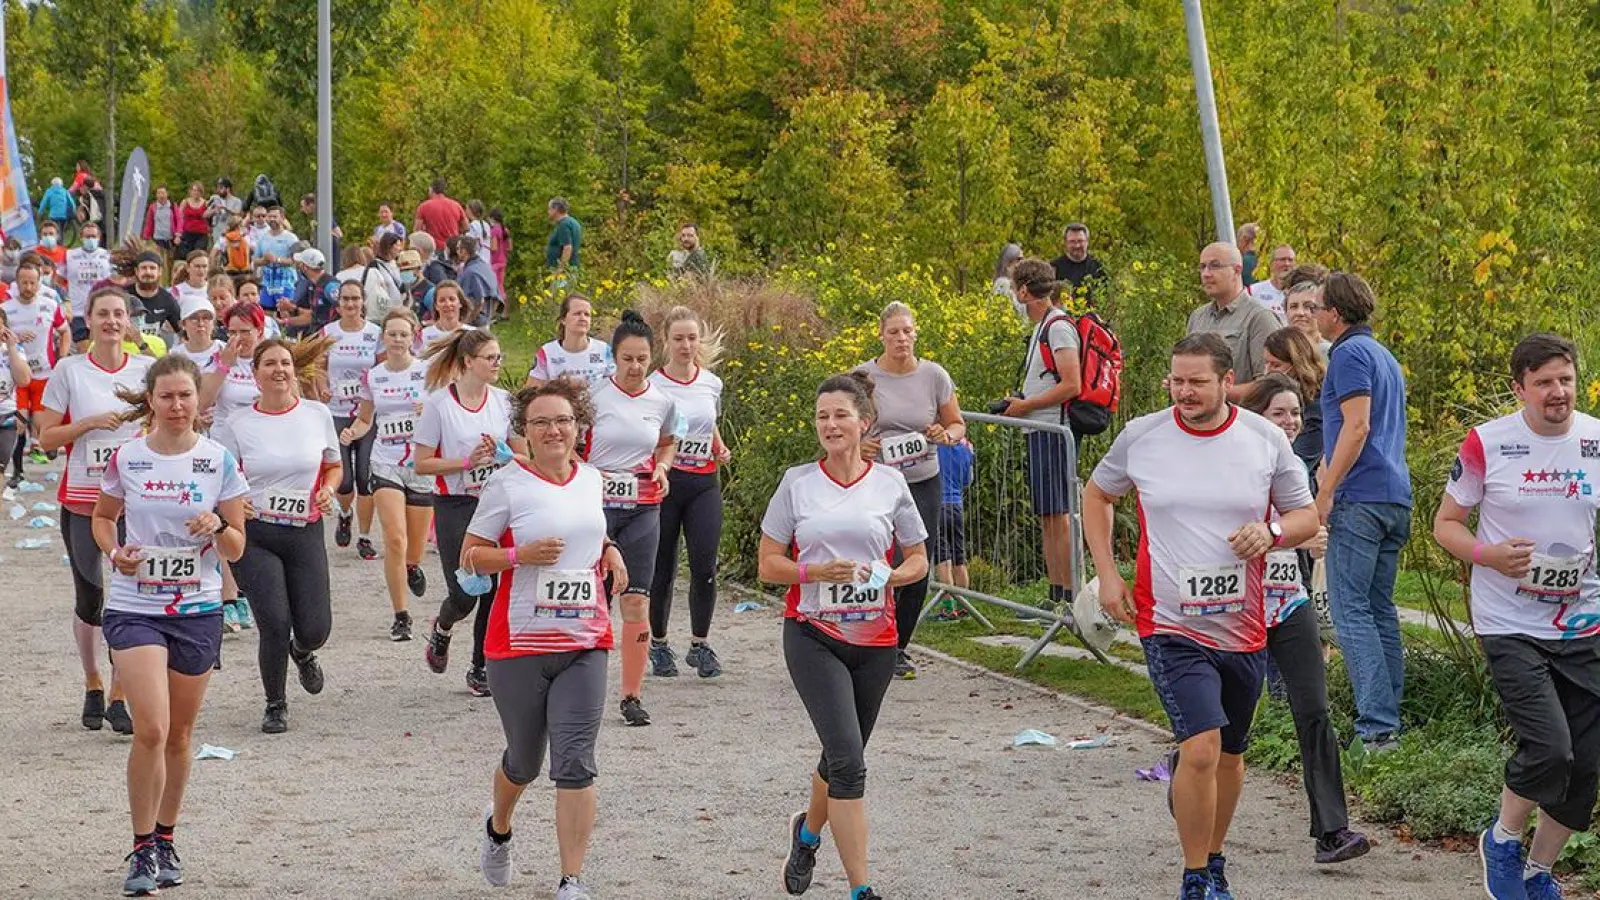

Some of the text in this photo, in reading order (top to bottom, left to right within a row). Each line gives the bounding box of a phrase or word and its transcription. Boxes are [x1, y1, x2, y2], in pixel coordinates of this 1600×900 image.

[384, 420, 414, 434] 1118
[676, 440, 709, 454] 1274
[888, 440, 922, 458] 1180
[603, 480, 633, 496] 281
[269, 496, 305, 514] 1276
[147, 557, 195, 577] 1125
[1263, 562, 1297, 582] 233
[1531, 566, 1579, 587] 1283
[545, 581, 591, 601] 1279
[1187, 574, 1239, 597] 1282
